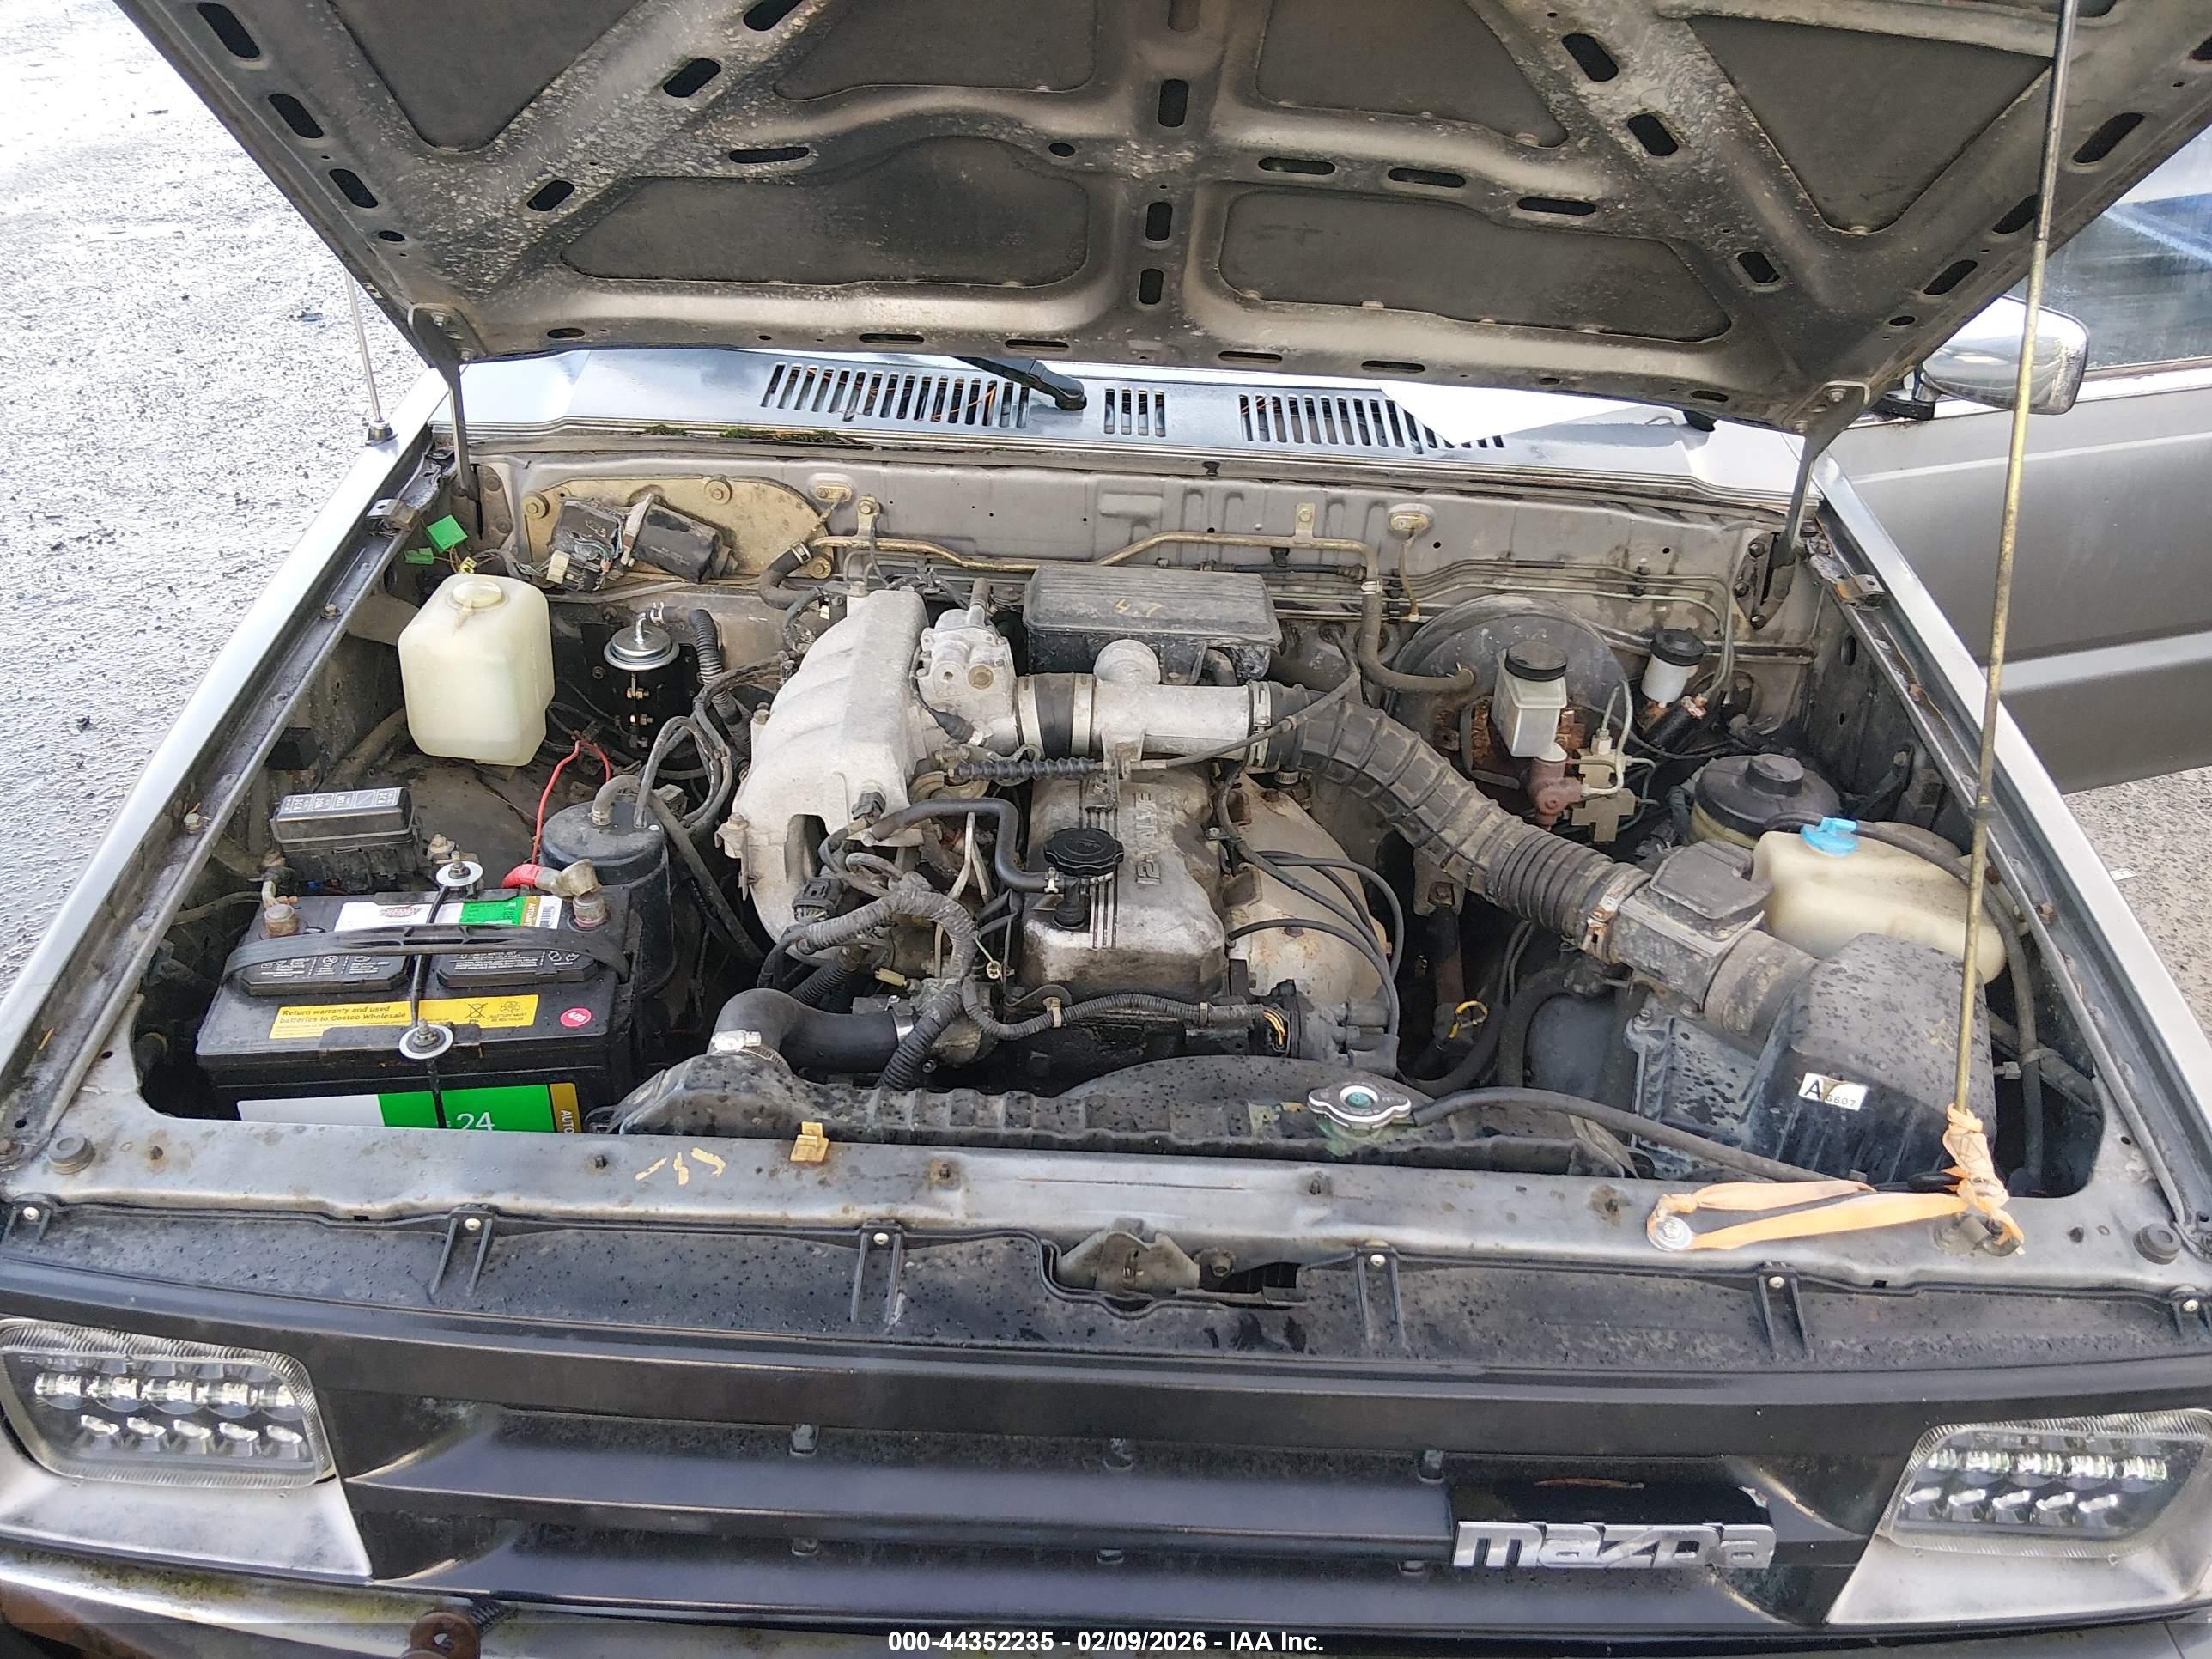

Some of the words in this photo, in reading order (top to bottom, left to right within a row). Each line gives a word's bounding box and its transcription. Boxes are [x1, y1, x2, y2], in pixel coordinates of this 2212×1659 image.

[313, 1007, 349, 1016] warranty
[1804, 1079, 1820, 1098] A
[457, 1112, 495, 1131] 24
[1452, 1521, 1778, 1569] mazda
